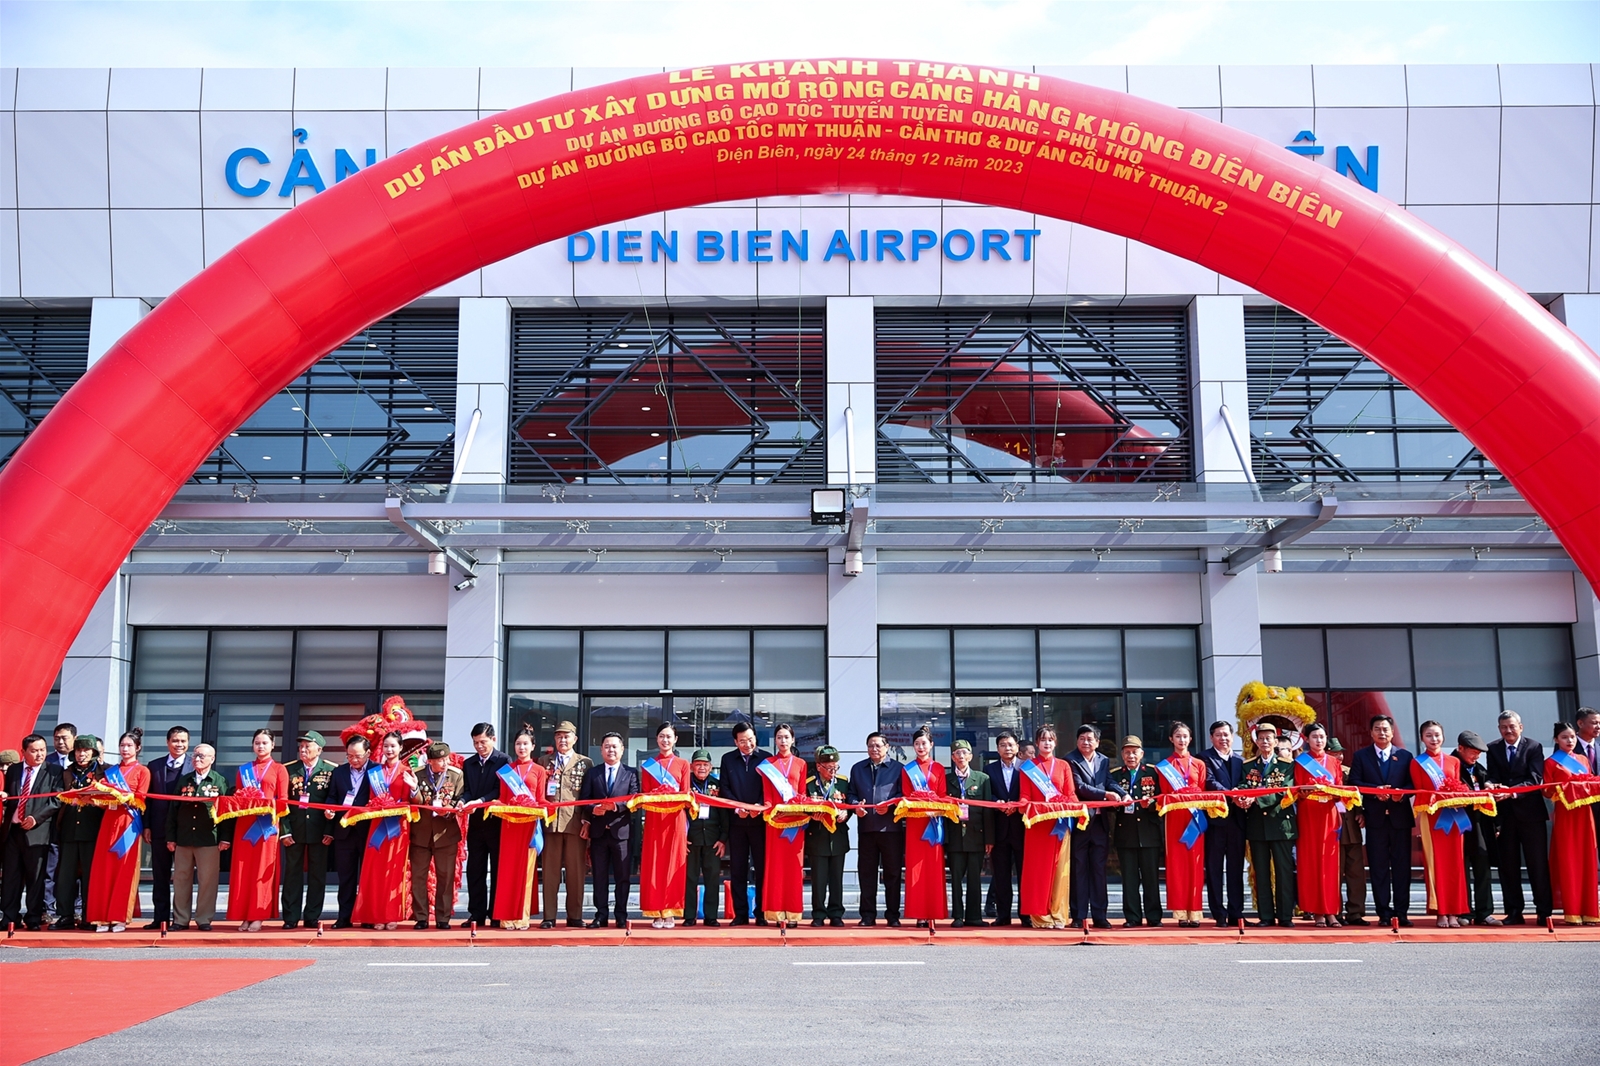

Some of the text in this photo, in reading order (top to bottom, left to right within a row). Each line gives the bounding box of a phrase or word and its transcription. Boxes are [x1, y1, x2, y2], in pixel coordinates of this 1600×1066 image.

[892, 61, 1040, 92] THÀNH
[224, 128, 408, 198] CẢN
[384, 76, 1343, 229] DỰ ÁN ĐẦU TƯ XÂY DỰNG MỞ RỘNG CẢNG HÀNG KHÔNG ĐIỆN BIÊN
[517, 167, 546, 189] DỰ
[551, 160, 579, 180] ÁN
[584, 141, 656, 170] ĐƯỜNG
[661, 131, 688, 154] BỘ
[692, 128, 731, 147] CAO
[735, 117, 774, 140] TỐC
[778, 118, 809, 138] MỸ
[814, 119, 882, 142] THUẬN
[899, 121, 941, 143] CẦN
[944, 129, 983, 146] THƠ
[986, 133, 1002, 149] &
[1004, 137, 1036, 158] DỰ
[1036, 140, 1067, 163] ÁN
[1068, 148, 1111, 173] CẦU
[1112, 163, 1146, 184] MỸ
[1149, 173, 1214, 209] THUẬN
[1212, 200, 1229, 216] 2
[566, 132, 594, 152] DỰ
[599, 125, 628, 145] ÁN
[633, 113, 702, 138] ĐƯỜNG
[706, 104, 734, 125] BỘ
[739, 102, 779, 119] CAO
[786, 99, 823, 117] TỐC
[831, 99, 894, 119] TUYẾN
[901, 103, 964, 123] TUYÊN
[971, 110, 1040, 136] QUANG
[1056, 129, 1098, 150] PHÚ
[1105, 141, 1144, 167] THỌ
[716, 143, 1024, 175] Điện Biên, ngày 24 tháng 12 năm 2023
[566, 228, 1042, 263] DIEN BIEN AIRPORT
